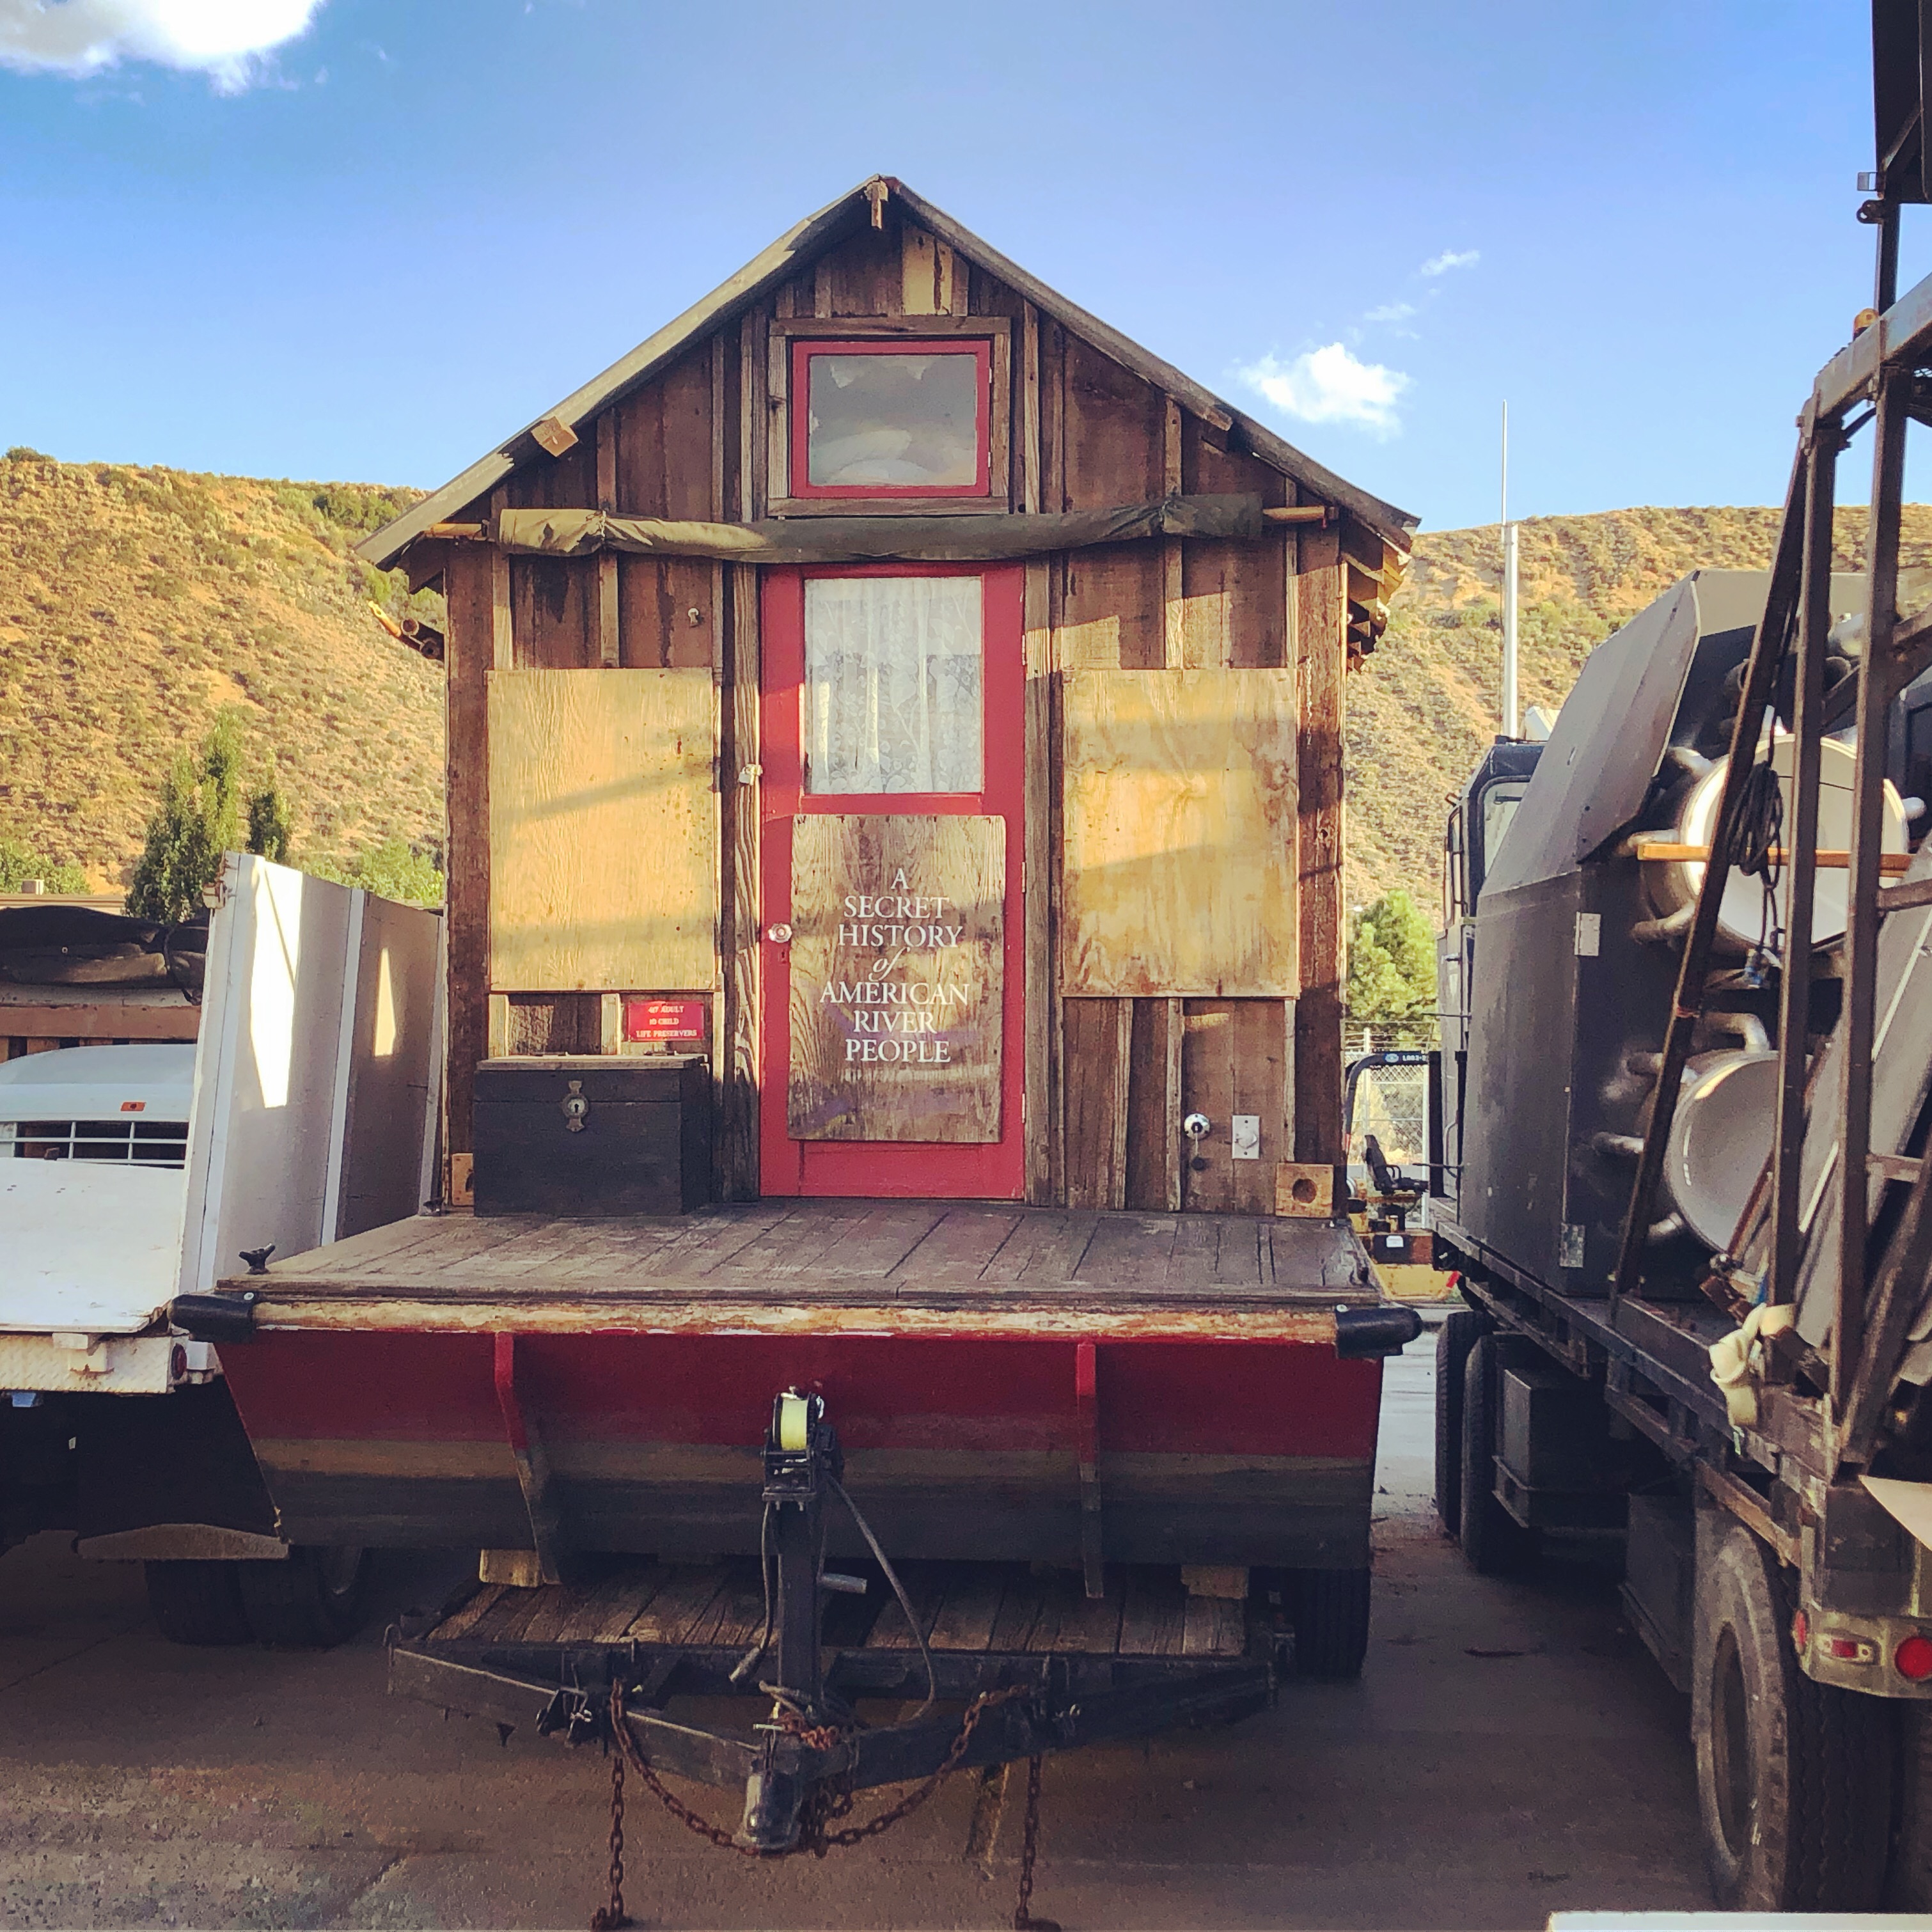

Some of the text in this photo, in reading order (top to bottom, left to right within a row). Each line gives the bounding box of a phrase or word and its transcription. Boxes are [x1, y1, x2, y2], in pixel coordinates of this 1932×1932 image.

[891, 868, 910, 889] A
[844, 895, 950, 919] SECRET
[838, 924, 963, 947] HISTORY
[868, 946, 910, 982] of
[819, 981, 970, 1006] AMERICAN
[853, 1010, 938, 1034] RIVER
[845, 1039, 951, 1063] PEOPLE
